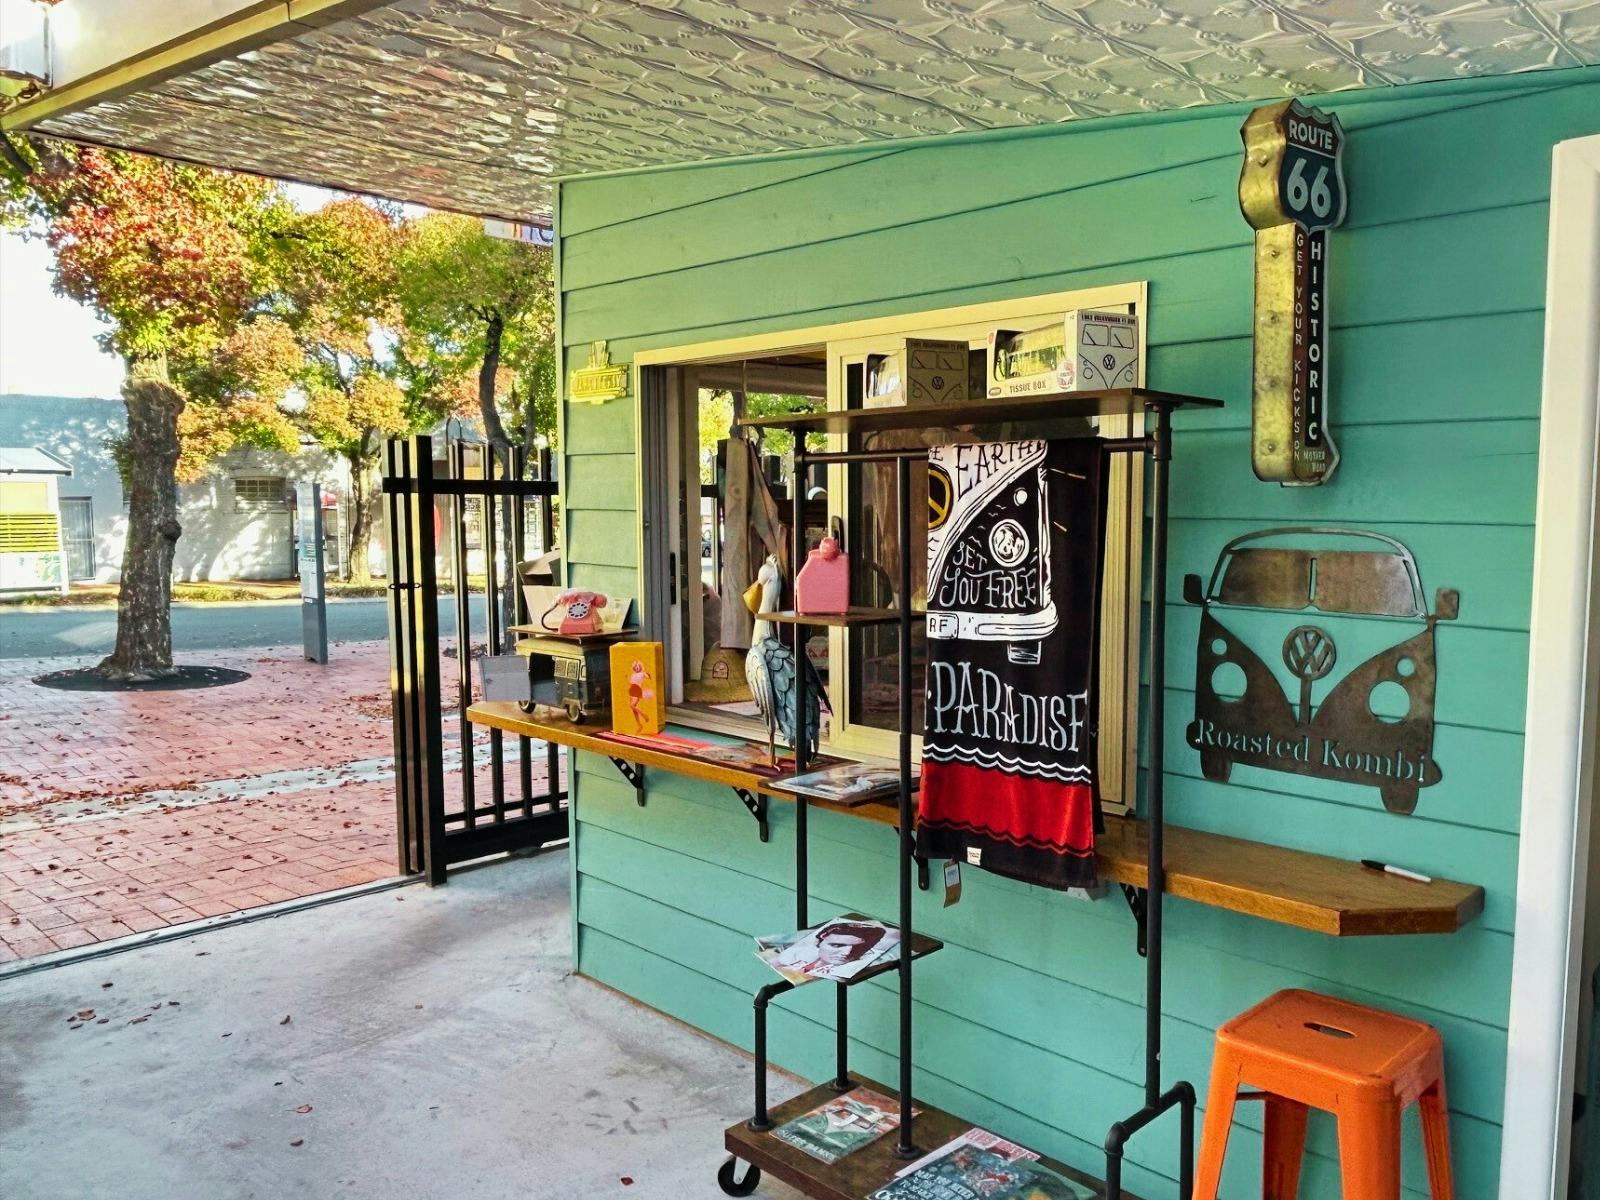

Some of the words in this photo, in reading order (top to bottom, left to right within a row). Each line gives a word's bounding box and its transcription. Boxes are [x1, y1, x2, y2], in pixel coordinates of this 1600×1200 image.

[1289, 119, 1333, 150] ROUTE
[1287, 157, 1331, 218] 66
[1296, 233, 1304, 275] GET
[1295, 287, 1303, 346] YOUR
[1308, 241, 1321, 441] HISTORIC
[1009, 382, 1031, 394] TISSUE
[1033, 380, 1047, 390] BOX
[1294, 360, 1302, 434] KICKS
[939, 565, 984, 608] YOU
[985, 567, 1037, 609] FREE
[1197, 719, 1310, 763] Roasted
[1322, 738, 1426, 783] Kombi
